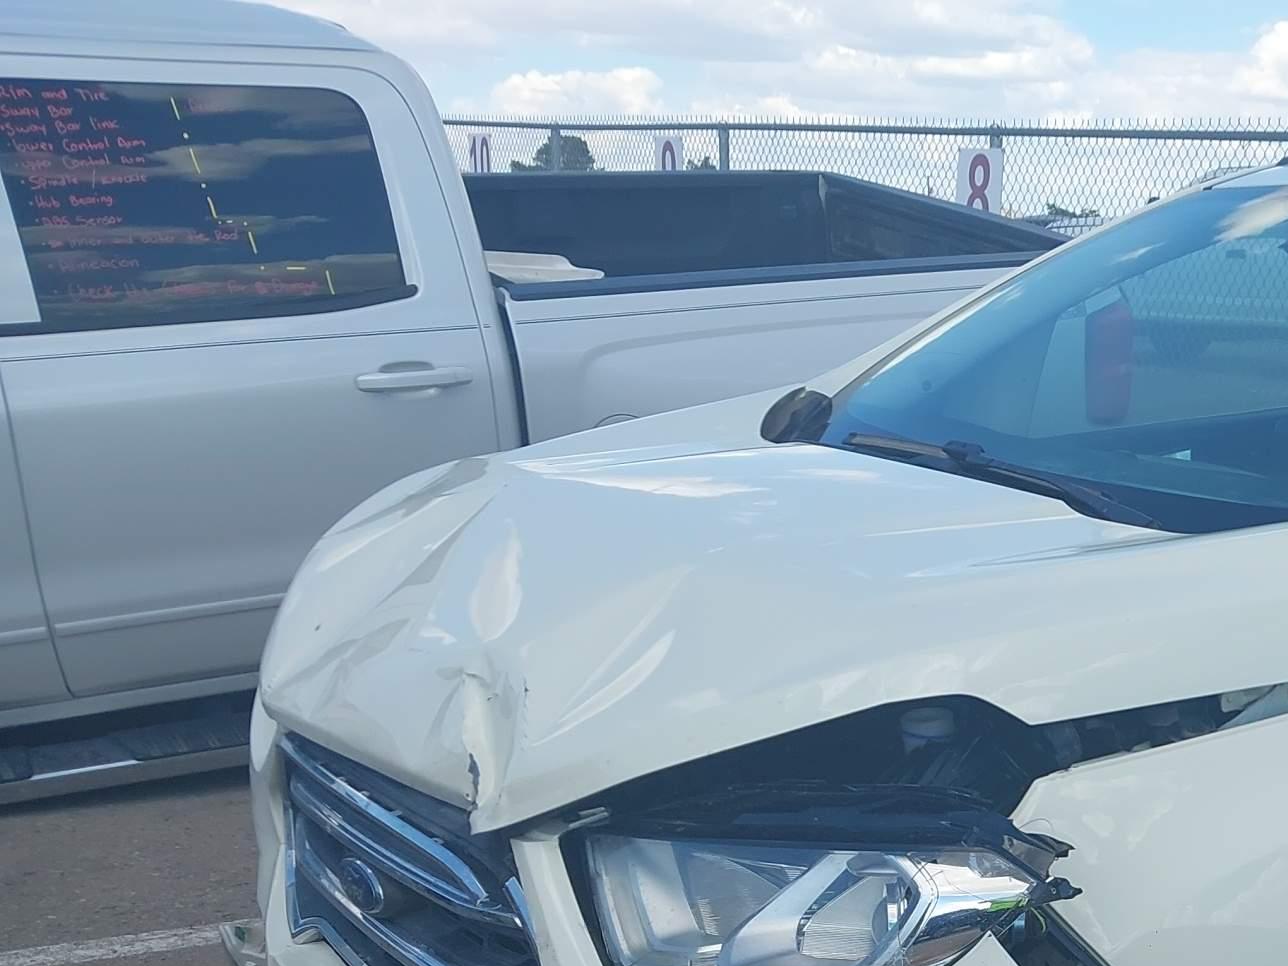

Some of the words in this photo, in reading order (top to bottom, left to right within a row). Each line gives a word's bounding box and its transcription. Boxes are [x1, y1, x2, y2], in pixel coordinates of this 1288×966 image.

[41, 87, 68, 100] and
[0, 104, 40, 119] Sway
[47, 104, 73, 118] Bar
[6, 122, 47, 137] Sway
[54, 119, 80, 135] Bar
[62, 136, 110, 153] Control
[62, 153, 110, 169] Control
[967, 153, 991, 212] 8
[68, 192, 113, 207] Bearing
